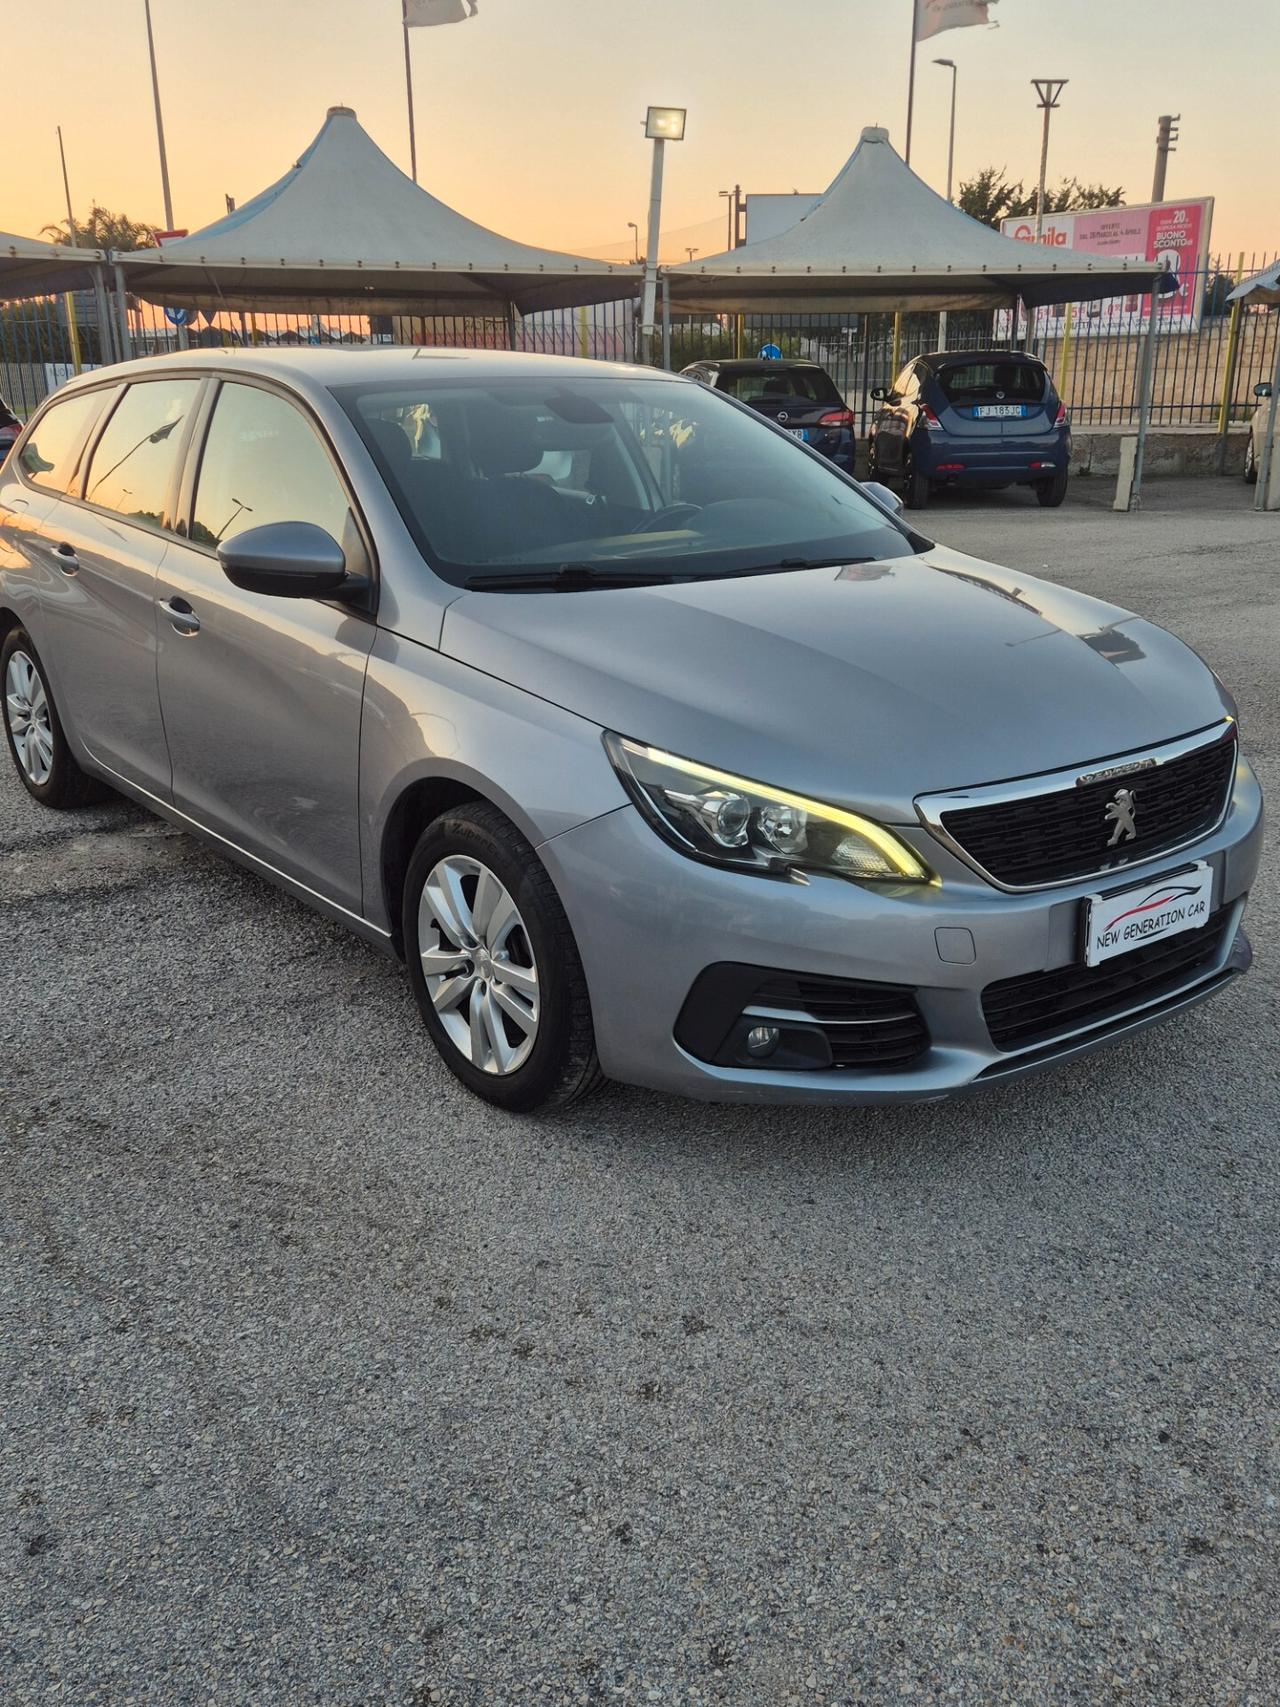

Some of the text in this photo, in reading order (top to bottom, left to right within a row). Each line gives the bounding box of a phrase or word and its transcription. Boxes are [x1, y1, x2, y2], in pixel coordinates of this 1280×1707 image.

[1173, 210, 1186, 223] 20
[1156, 230, 1186, 240] BUONO
[1153, 239, 1187, 249] SCONTO
[1096, 900, 1206, 949] NEW GENERATION CAR
